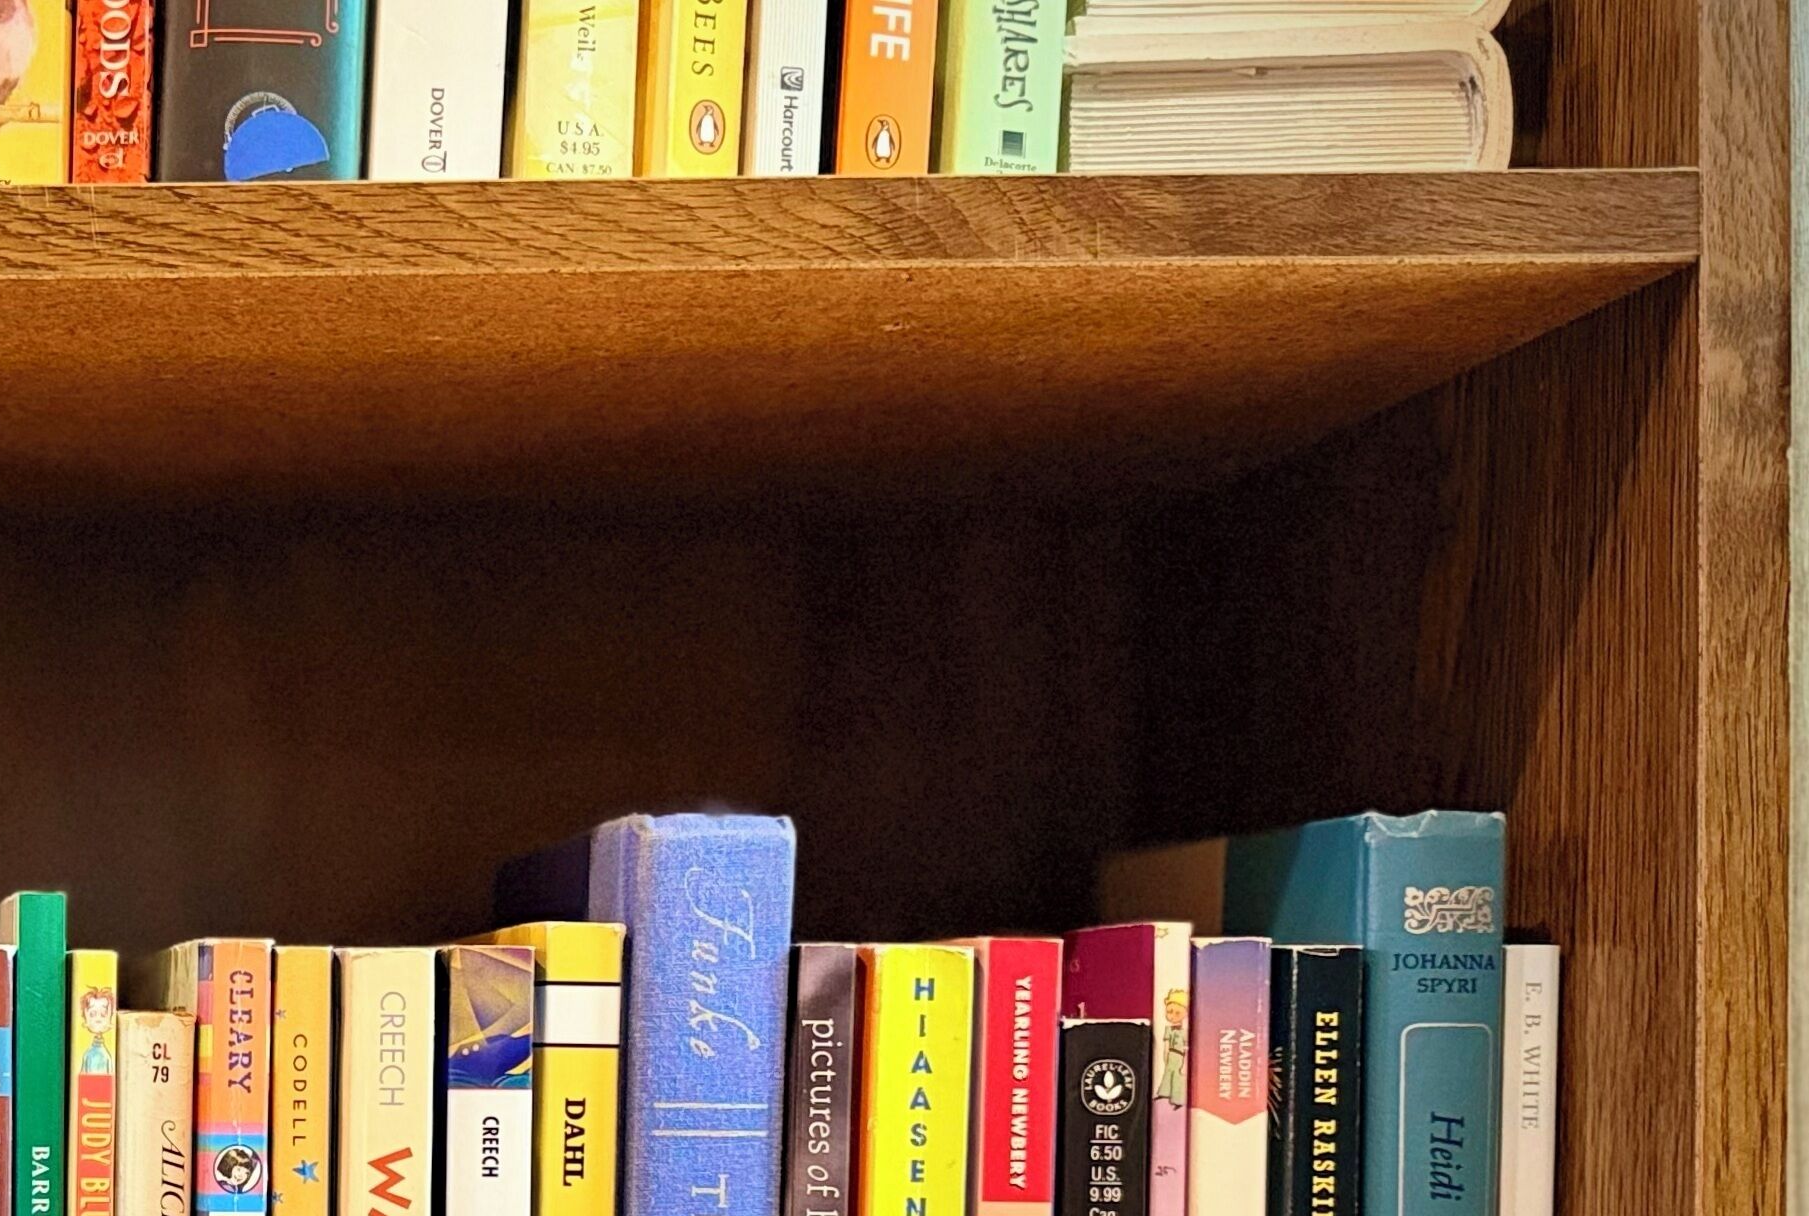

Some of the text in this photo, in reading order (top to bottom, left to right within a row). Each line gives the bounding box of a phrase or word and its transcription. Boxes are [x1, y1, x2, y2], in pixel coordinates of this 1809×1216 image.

[83, 131, 139, 146] DOVER
[428, 87, 444, 150] DOVER
[780, 95, 799, 172] Harcourt
[545, 162, 575, 174] CAN
[1392, 953, 1496, 972] JOHANNA
[1417, 977, 1477, 994] SPYRI
[228, 968, 254, 1094] CLEARY
[379, 991, 406, 1106] CREECH
[1219, 1028, 1238, 1100] NEWBERY
[1239, 1028, 1257, 1099] ALADDIN
[1312, 1011, 1339, 1105] ELLEN
[1522, 982, 1542, 1130] E. B. WHITE
[152, 1066, 169, 1083] 79
[293, 1034, 308, 1146] CODELL
[802, 1017, 843, 1155] pictures
[1008, 975, 1033, 1190] YEARLING NEWBERY
[1088, 1099, 1128, 1112] BOOKS
[80, 1097, 112, 1171] JUDY
[482, 1116, 499, 1178] CREECH
[562, 1097, 586, 1187] DAHL
[1090, 1145, 1122, 1161] 6.50
[1095, 1124, 1119, 1140] FIC
[1429, 1111, 1465, 1201] Heidi
[806, 1165, 839, 1198] of
[1089, 1187, 1122, 1203] 9.99
[1091, 1166, 1121, 1182] U.S.
